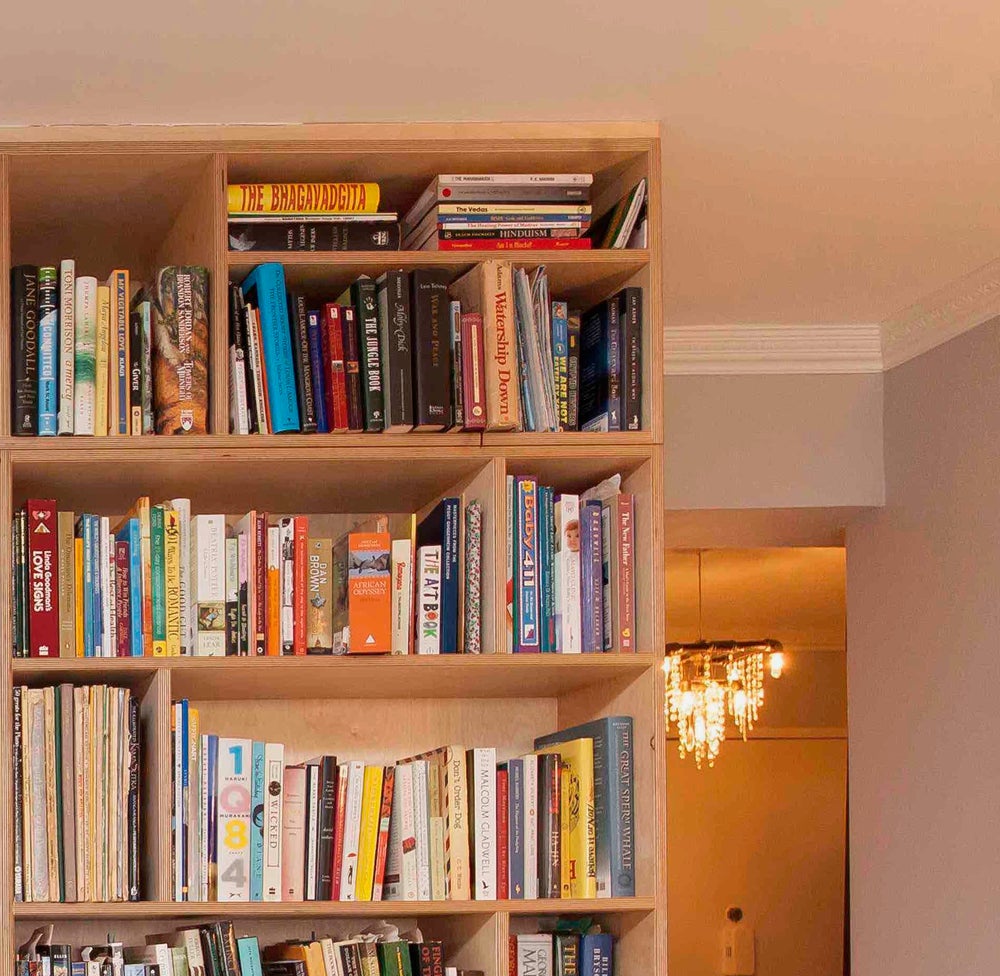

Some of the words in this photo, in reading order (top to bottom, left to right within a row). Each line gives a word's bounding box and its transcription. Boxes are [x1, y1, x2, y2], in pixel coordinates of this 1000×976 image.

[240, 185, 263, 211] THE
[271, 185, 366, 211] BHAGAVADGITA
[500, 229, 547, 238] HINDUISM
[24, 273, 36, 305] JANE
[177, 274, 185, 307] BRANDON
[365, 318, 377, 335] THE
[494, 292, 509, 365] Watership
[25, 310, 37, 375] GOODALL
[365, 337, 379, 368] JUNGLE
[132, 369, 140, 391] GIVER
[368, 370, 380, 391] BOOK
[560, 356, 566, 375] WE
[499, 370, 511, 415] Down
[522, 495, 534, 551] Baby
[33, 550, 43, 580] LOVE
[523, 551, 534, 586] 411
[622, 543, 630, 565] Father
[310, 555, 319, 592] BROWN
[34, 582, 44, 612] SIGNS
[44, 571, 52, 611] Goodman's
[452, 760, 462, 783] Don't
[453, 785, 462, 811] Order
[480, 770, 490, 819] MALCOLM
[269, 799, 278, 849] WICKED
[454, 813, 462, 829] Dog
[481, 822, 490, 876] GLADWELL
[421, 946, 429, 964] OF
[564, 945, 576, 974] THE
